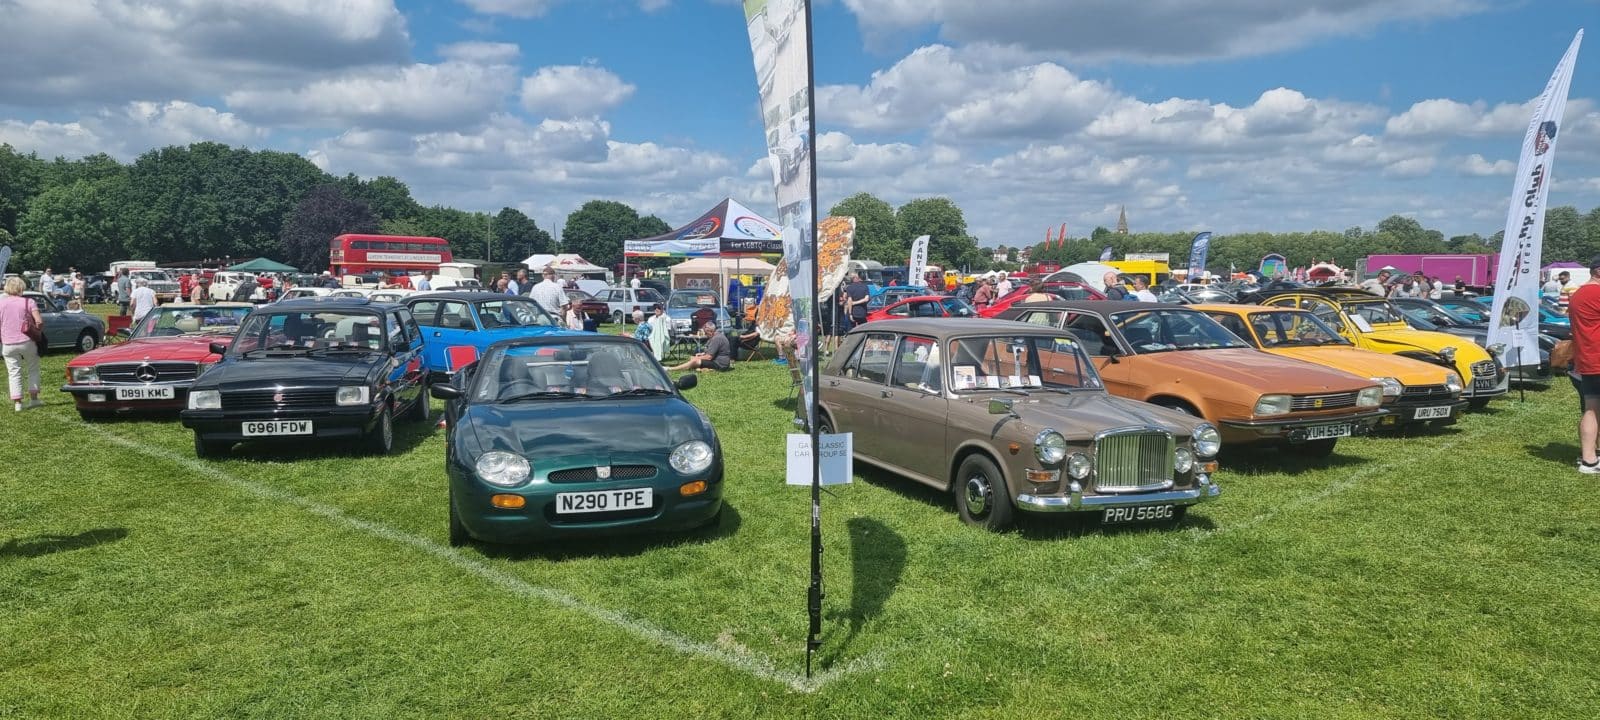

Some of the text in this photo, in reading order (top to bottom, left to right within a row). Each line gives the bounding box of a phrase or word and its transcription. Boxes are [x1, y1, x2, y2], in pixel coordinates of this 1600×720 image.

[121, 388, 169, 398] D891 KMC
[1417, 407, 1449, 417] URU 750X
[248, 422, 307, 433] G961 FDW
[1306, 424, 1350, 438] XUH 535T
[562, 490, 645, 510] N290 TPE
[1104, 504, 1174, 522] PRU 568G
